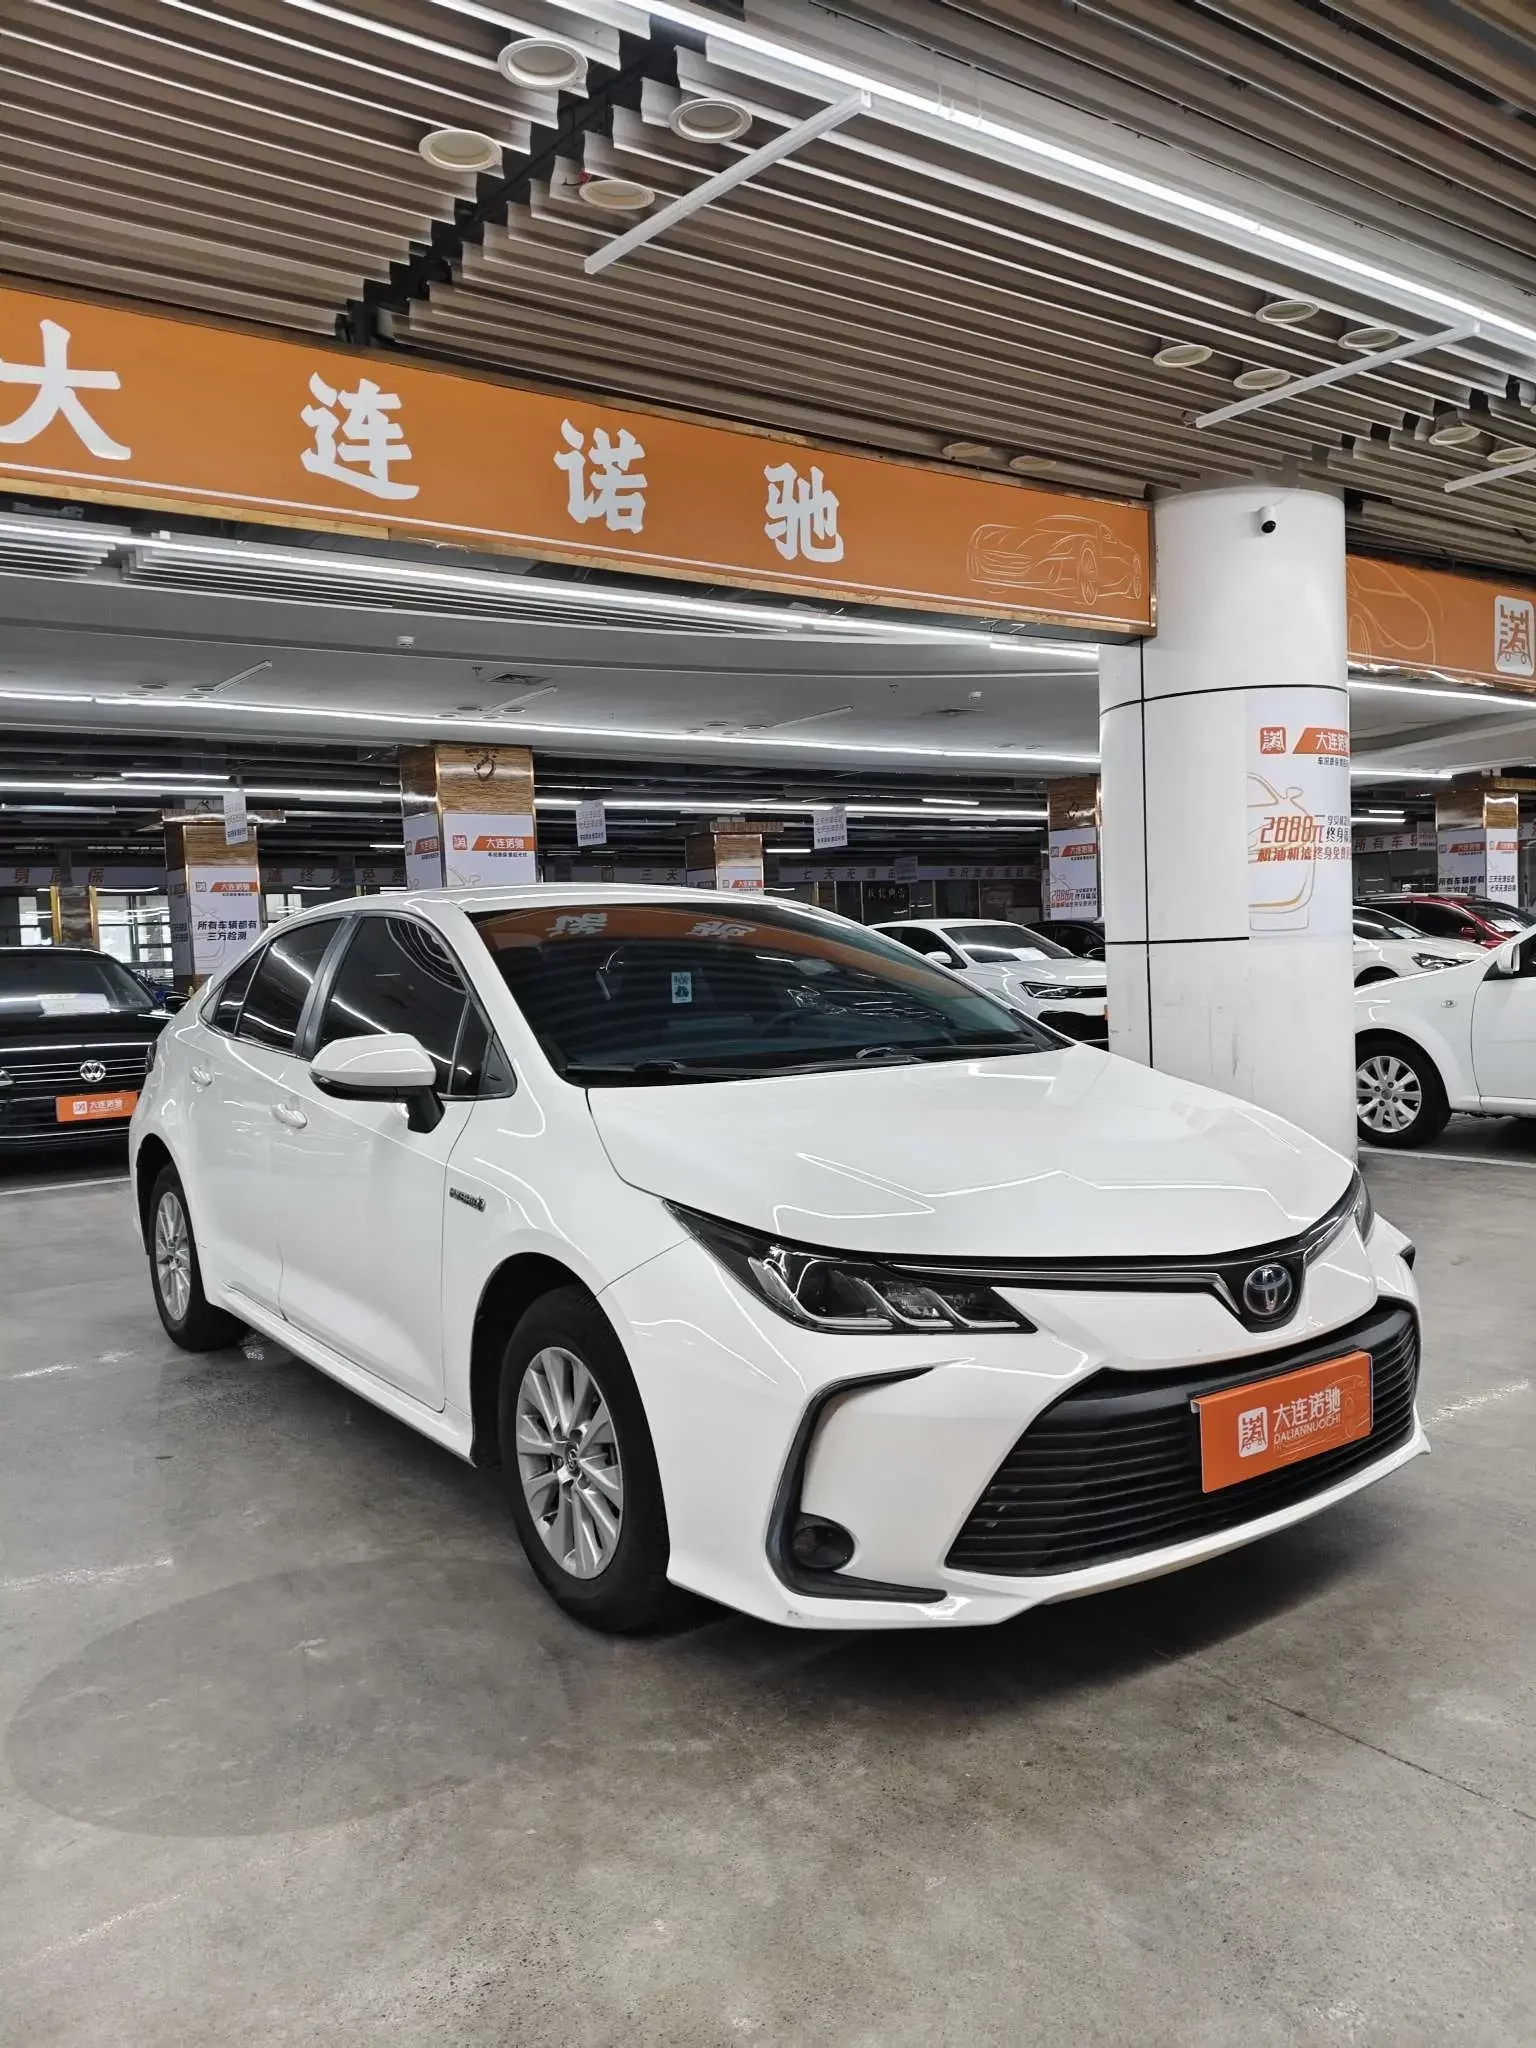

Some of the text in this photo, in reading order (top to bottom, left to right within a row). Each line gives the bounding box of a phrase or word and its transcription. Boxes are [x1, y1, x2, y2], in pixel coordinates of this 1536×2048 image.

[0, 318, 844, 564] 大连诺驰
[197, 920, 257, 931] 所有车辆都有
[207, 931, 247, 942] 三方检测
[1273, 1386, 1341, 1432] 大连诺驰
